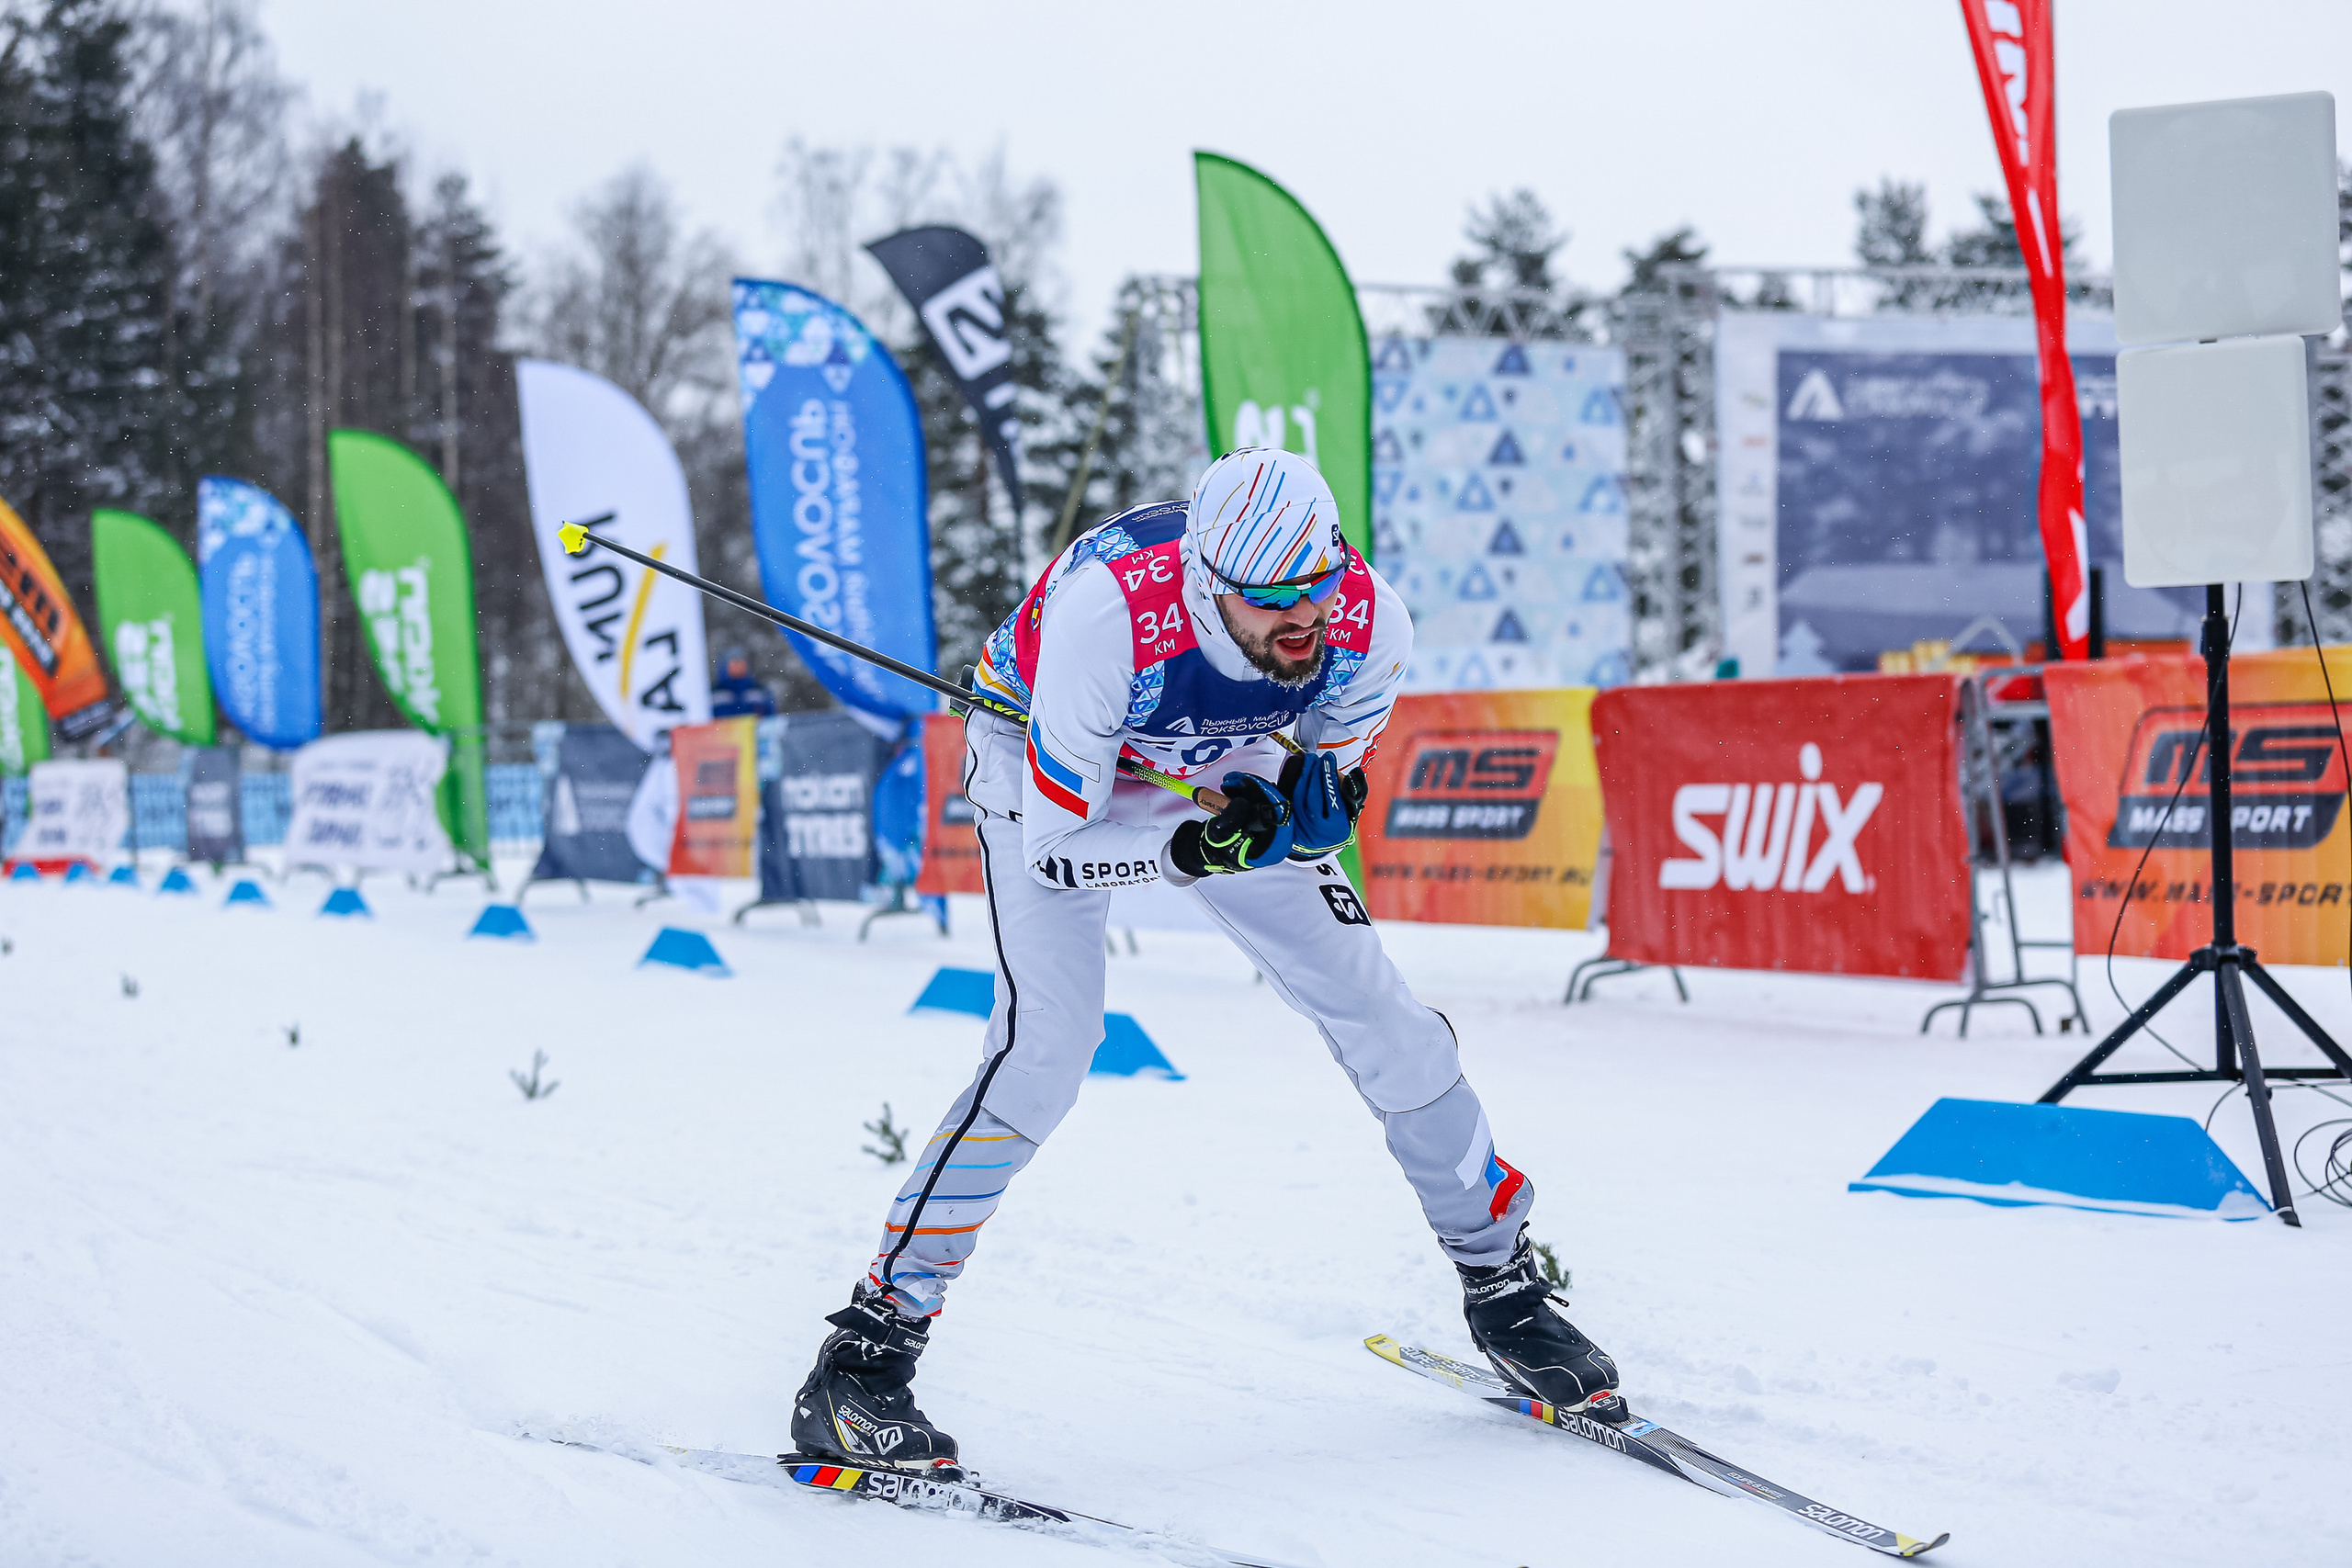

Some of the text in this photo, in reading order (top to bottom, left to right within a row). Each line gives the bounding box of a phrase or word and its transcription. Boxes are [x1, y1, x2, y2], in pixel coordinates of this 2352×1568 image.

[1131, 549, 1155, 565] KM
[1122, 555, 1174, 592] 34
[1136, 602, 1184, 645] 34
[1329, 627, 1352, 644] KM
[1154, 638, 1176, 656] KM
[2230, 804, 2313, 833] PORT
[1085, 875, 1161, 888] LABORATOR
[1557, 1409, 1627, 1453] salomon
[1797, 1504, 1885, 1540] salomon
